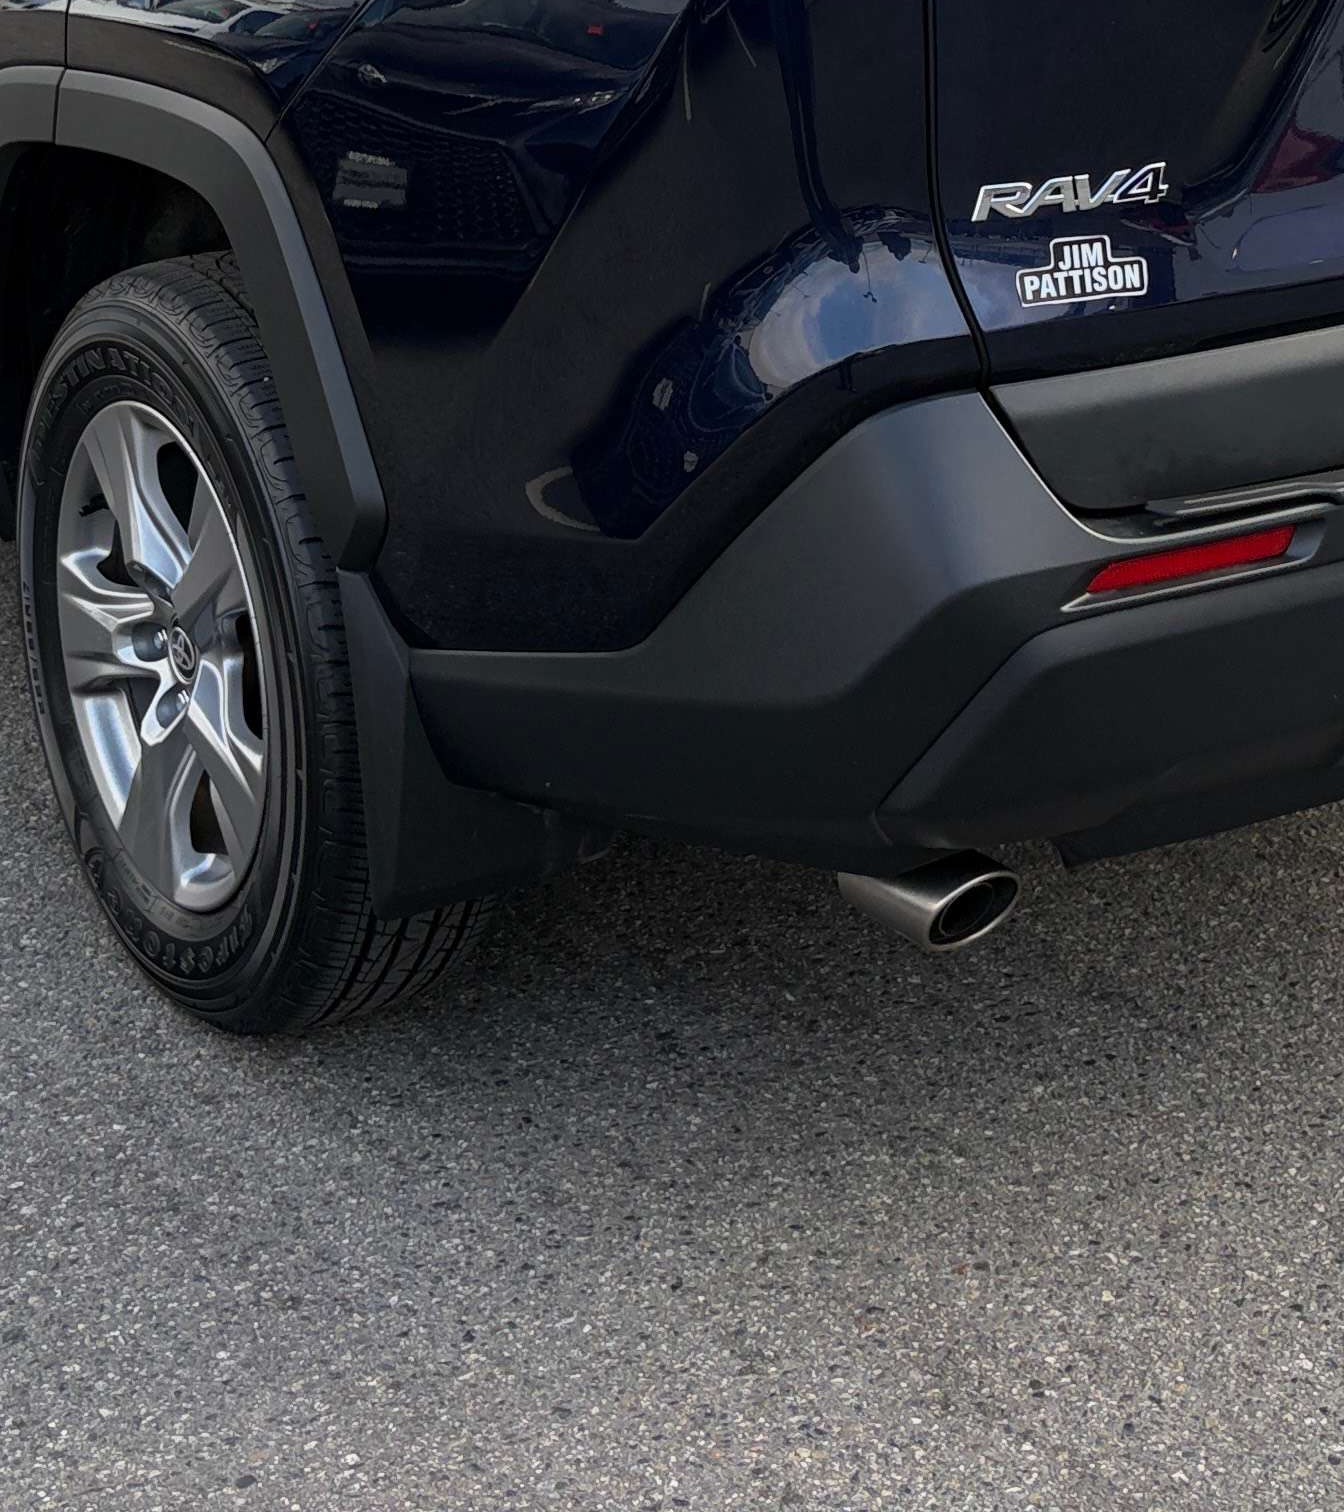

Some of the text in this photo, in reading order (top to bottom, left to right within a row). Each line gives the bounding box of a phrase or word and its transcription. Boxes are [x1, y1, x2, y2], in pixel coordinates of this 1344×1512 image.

[971, 162, 1169, 222] RAV4
[1058, 241, 1104, 271] JIM
[1023, 264, 1142, 301] PATTISON
